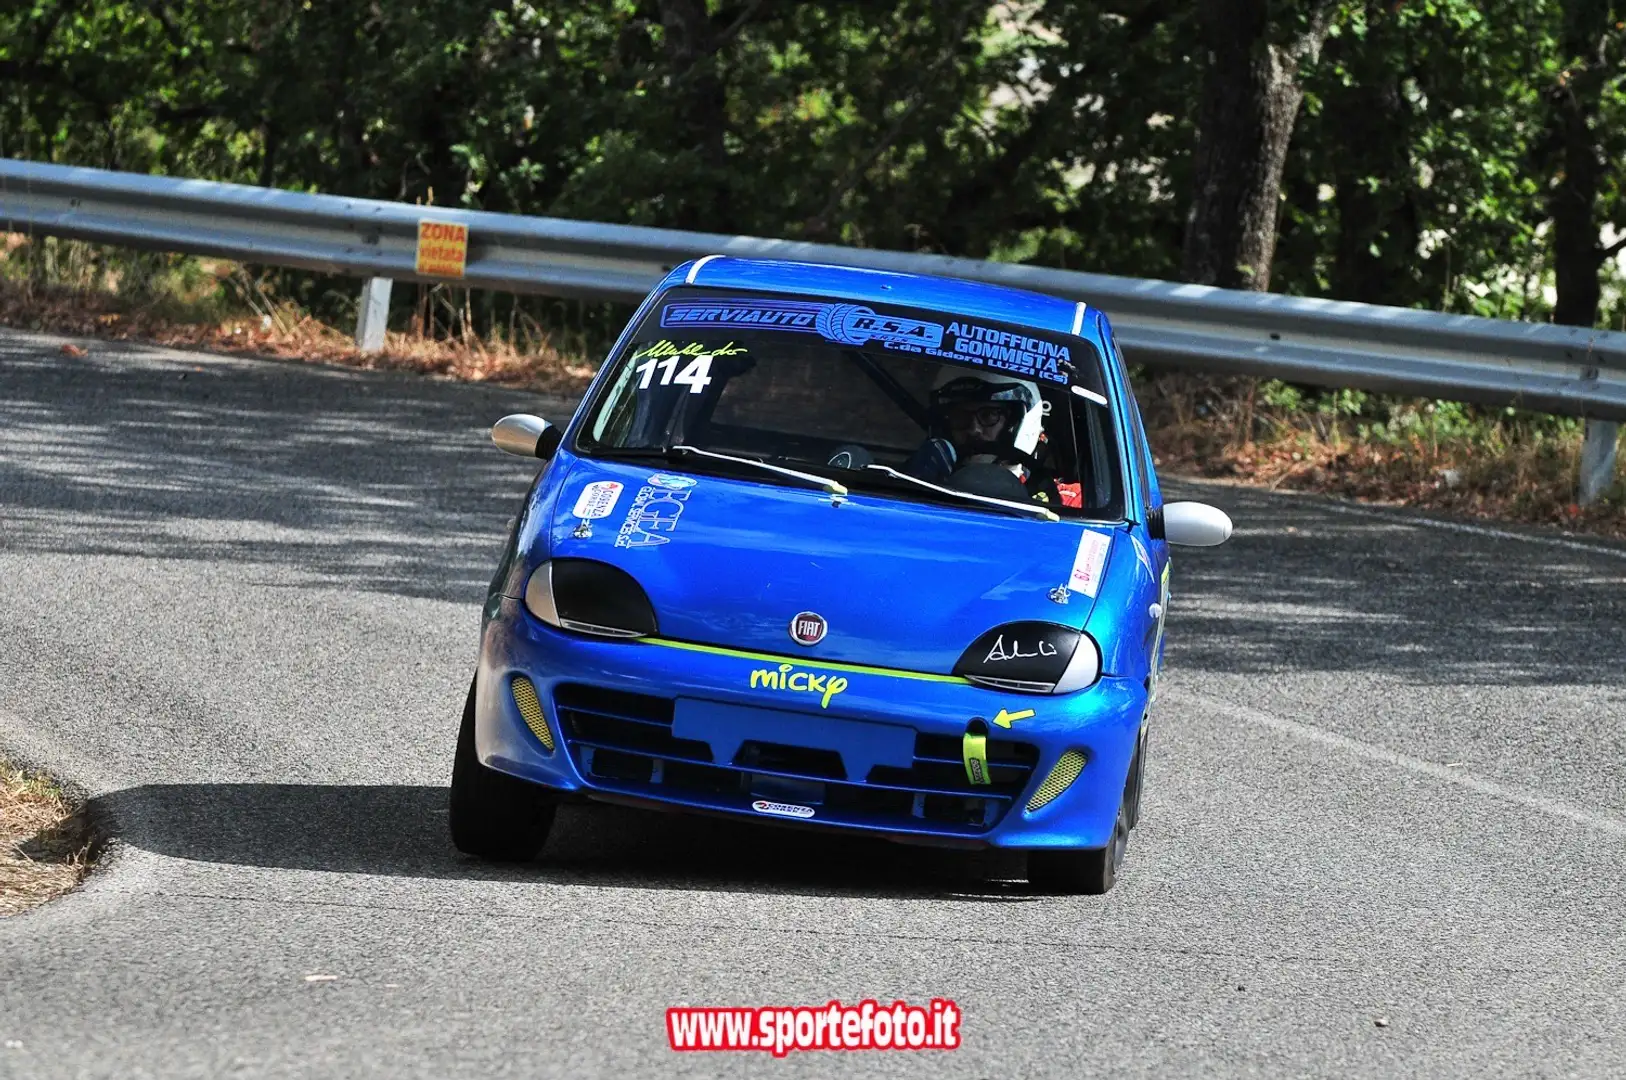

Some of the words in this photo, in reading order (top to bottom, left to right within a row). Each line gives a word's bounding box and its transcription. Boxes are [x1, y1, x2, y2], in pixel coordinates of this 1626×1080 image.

[421, 222, 465, 242] ZONA
[666, 308, 815, 326] SERVIAUTO
[946, 321, 1071, 362] AUTOFFICINA
[954, 337, 1058, 374] GOMMISTA
[635, 354, 714, 394] 114
[988, 358, 1035, 375] LUZZI
[797, 620, 821, 637] FIAT
[750, 663, 848, 709] micky
